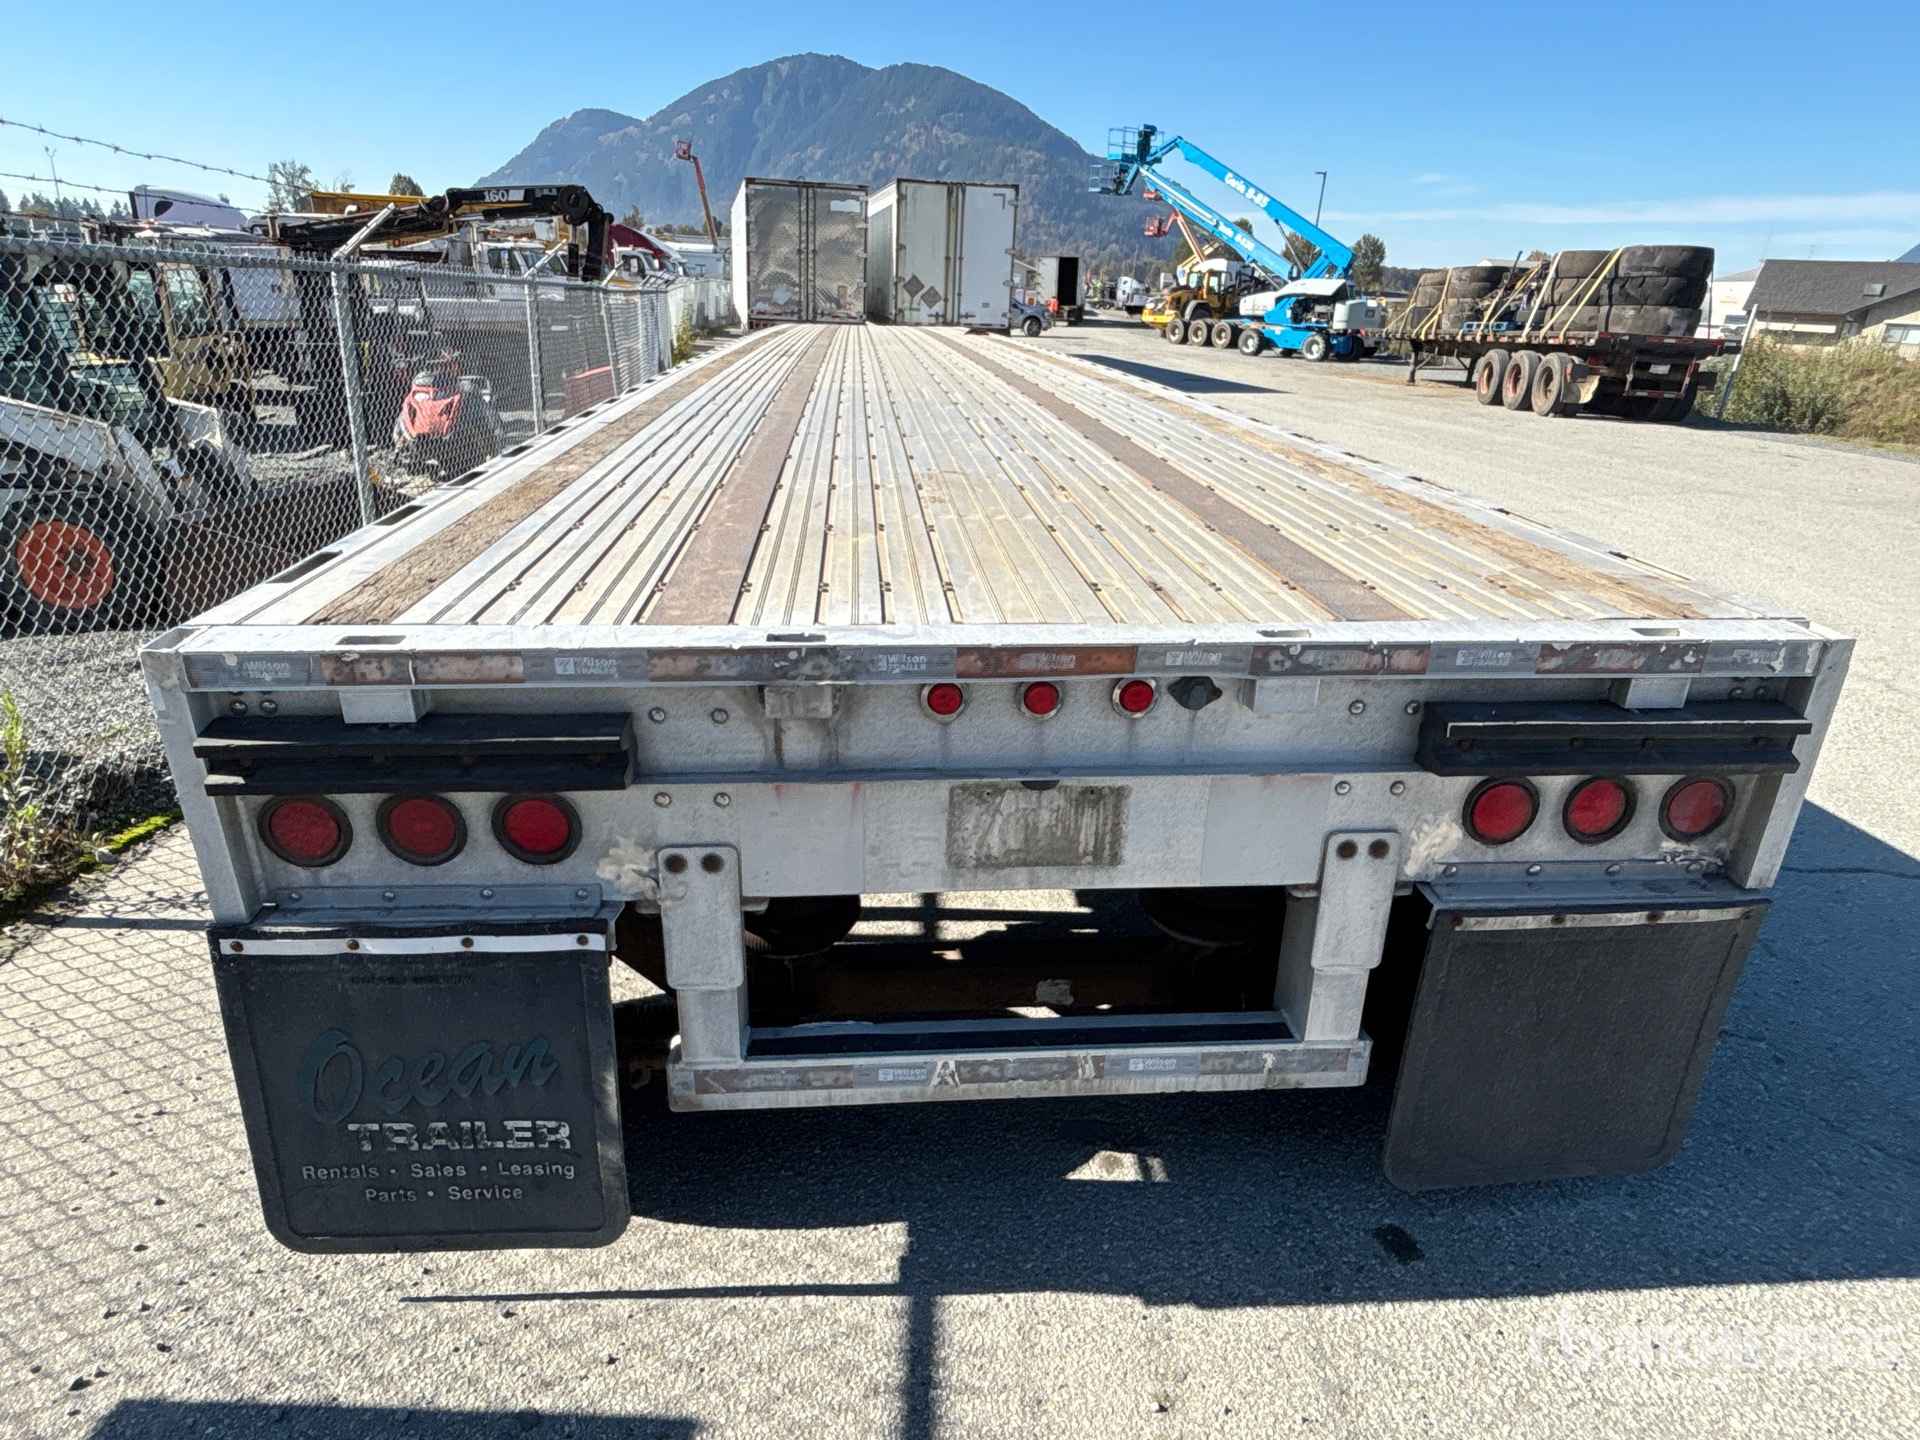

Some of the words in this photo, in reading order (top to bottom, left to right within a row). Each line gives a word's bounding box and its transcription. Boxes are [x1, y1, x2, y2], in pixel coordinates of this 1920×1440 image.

[483, 189, 508, 202] 160
[299, 1029, 559, 1126] Ocean
[346, 1119, 571, 1151] TRAILER
[301, 1163, 379, 1180] Rentals
[410, 1163, 467, 1178] Sales
[498, 1161, 575, 1181] Leasing
[364, 1187, 418, 1202] Parts
[447, 1185, 524, 1202] Service
